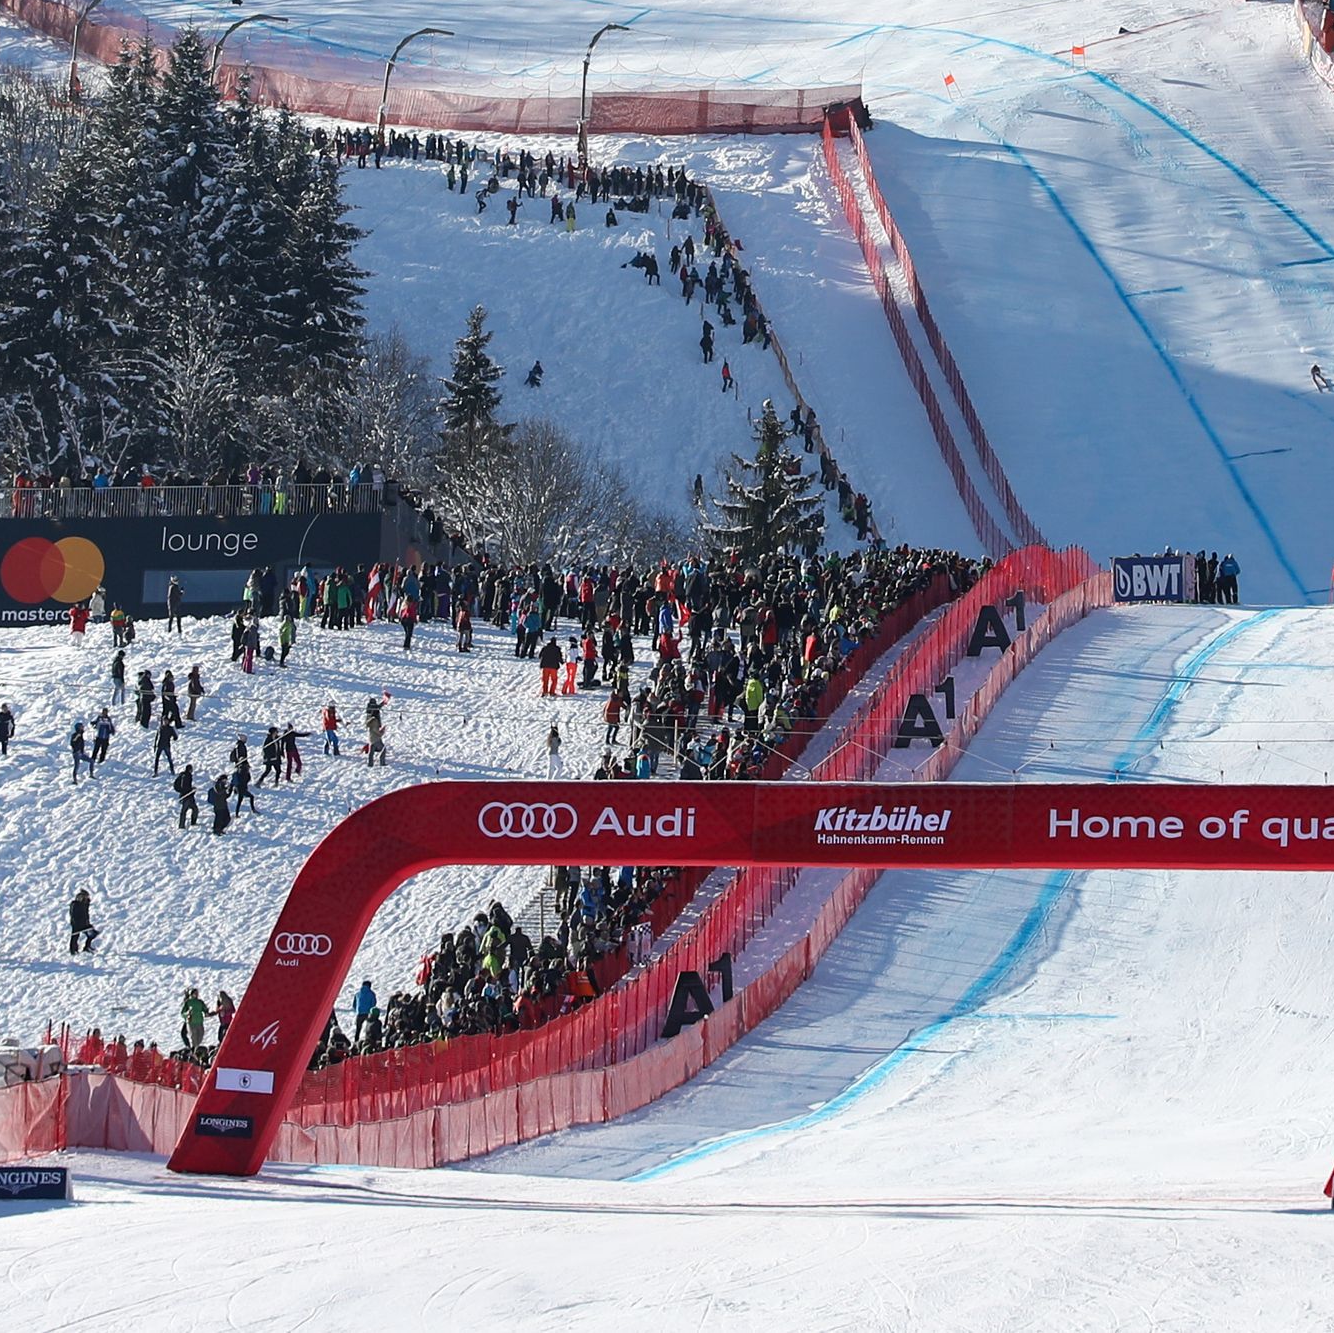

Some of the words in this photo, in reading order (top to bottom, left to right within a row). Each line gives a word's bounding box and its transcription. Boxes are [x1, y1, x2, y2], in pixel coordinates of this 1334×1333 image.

[162, 526, 258, 556] lounge
[1132, 563, 1181, 597] BWT
[1, 608, 70, 621] masterc
[966, 590, 1026, 656] A1
[894, 675, 956, 748] A1
[590, 806, 696, 837] Audi
[814, 805, 952, 833] Kitzbühel
[1048, 808, 1184, 839] Home
[1199, 809, 1250, 839] of
[816, 833, 945, 846] Hahnenkamm-Rennen
[275, 958, 299, 967] Audi
[660, 952, 733, 1038] A1
[200, 1116, 248, 1129] LONGINES
